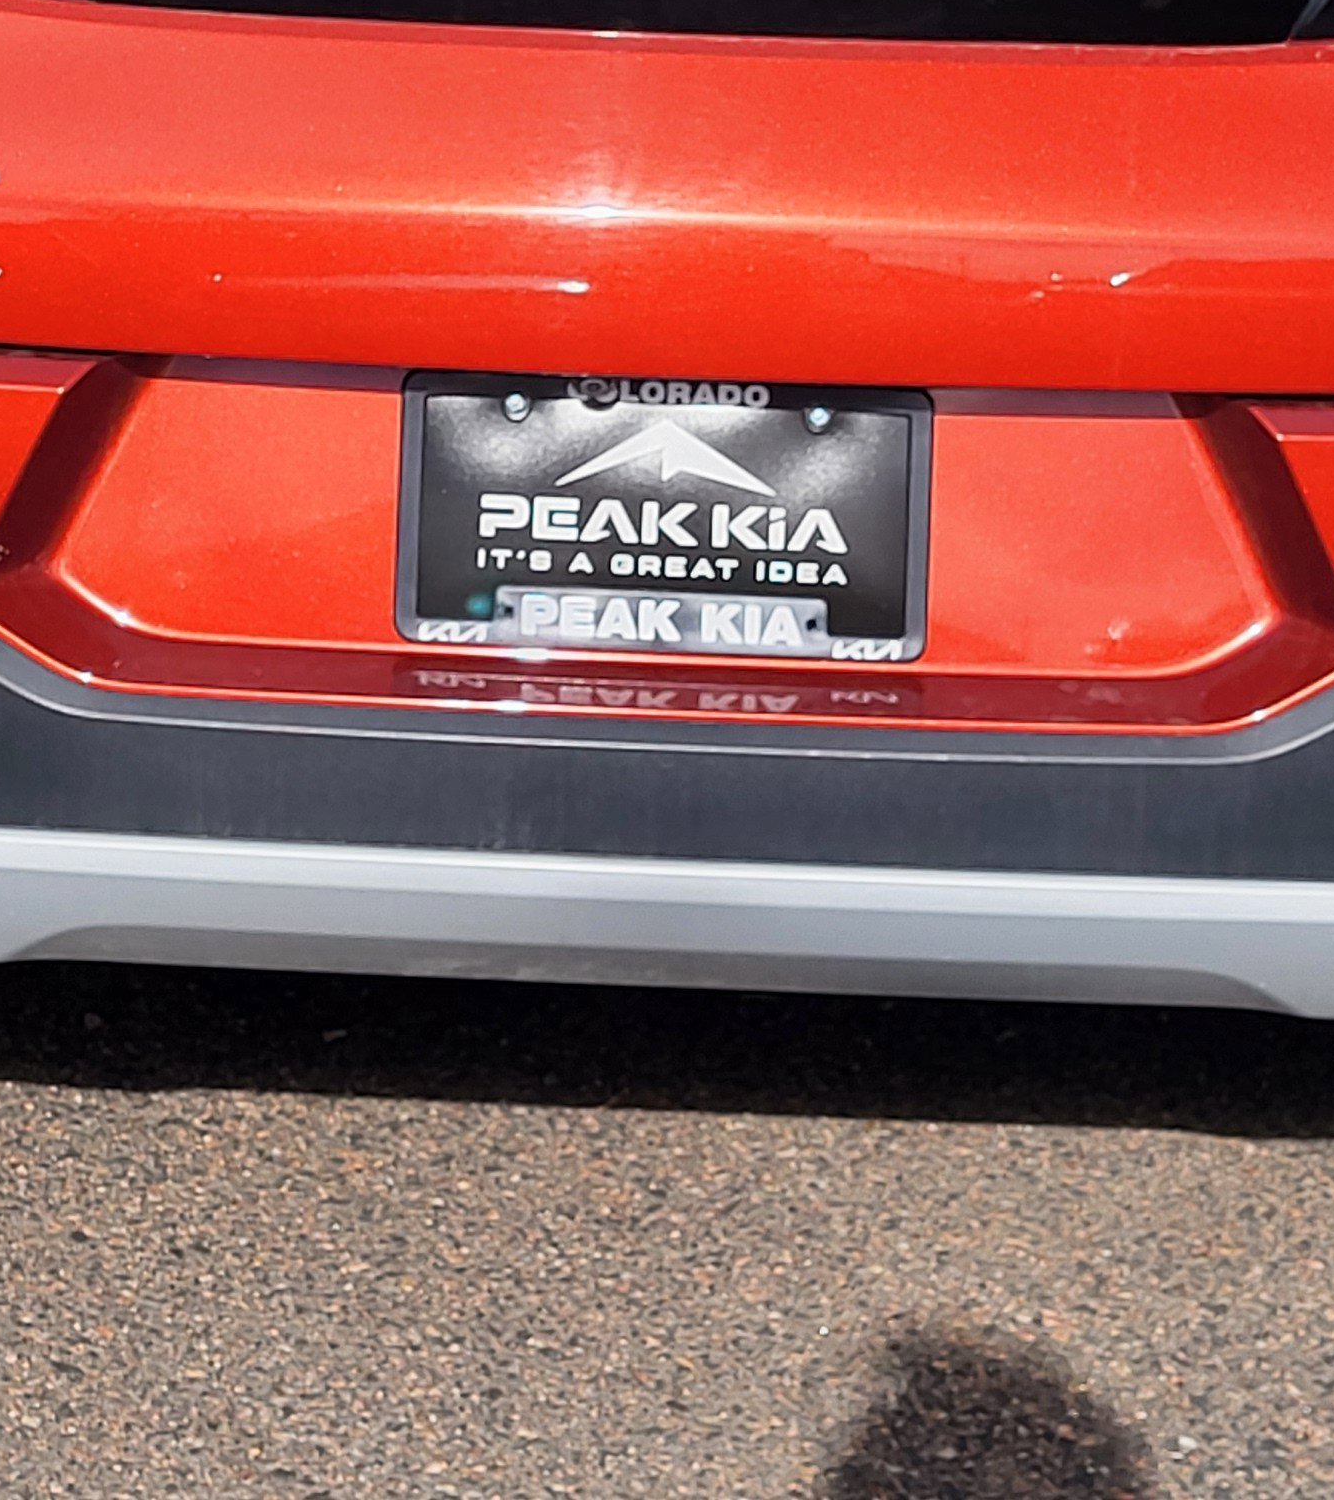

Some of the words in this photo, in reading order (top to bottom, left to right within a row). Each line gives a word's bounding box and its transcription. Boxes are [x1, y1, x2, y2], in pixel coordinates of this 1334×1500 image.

[477, 493, 700, 548] PEAK
[475, 546, 553, 573] IT'S
[567, 551, 595, 575] A
[609, 552, 740, 582] GREAT
[755, 559, 849, 587] IDEA
[417, 621, 490, 643] KIA
[520, 593, 682, 642] PEAK
[700, 602, 803, 647] KIA
[830, 639, 904, 661] KIA
